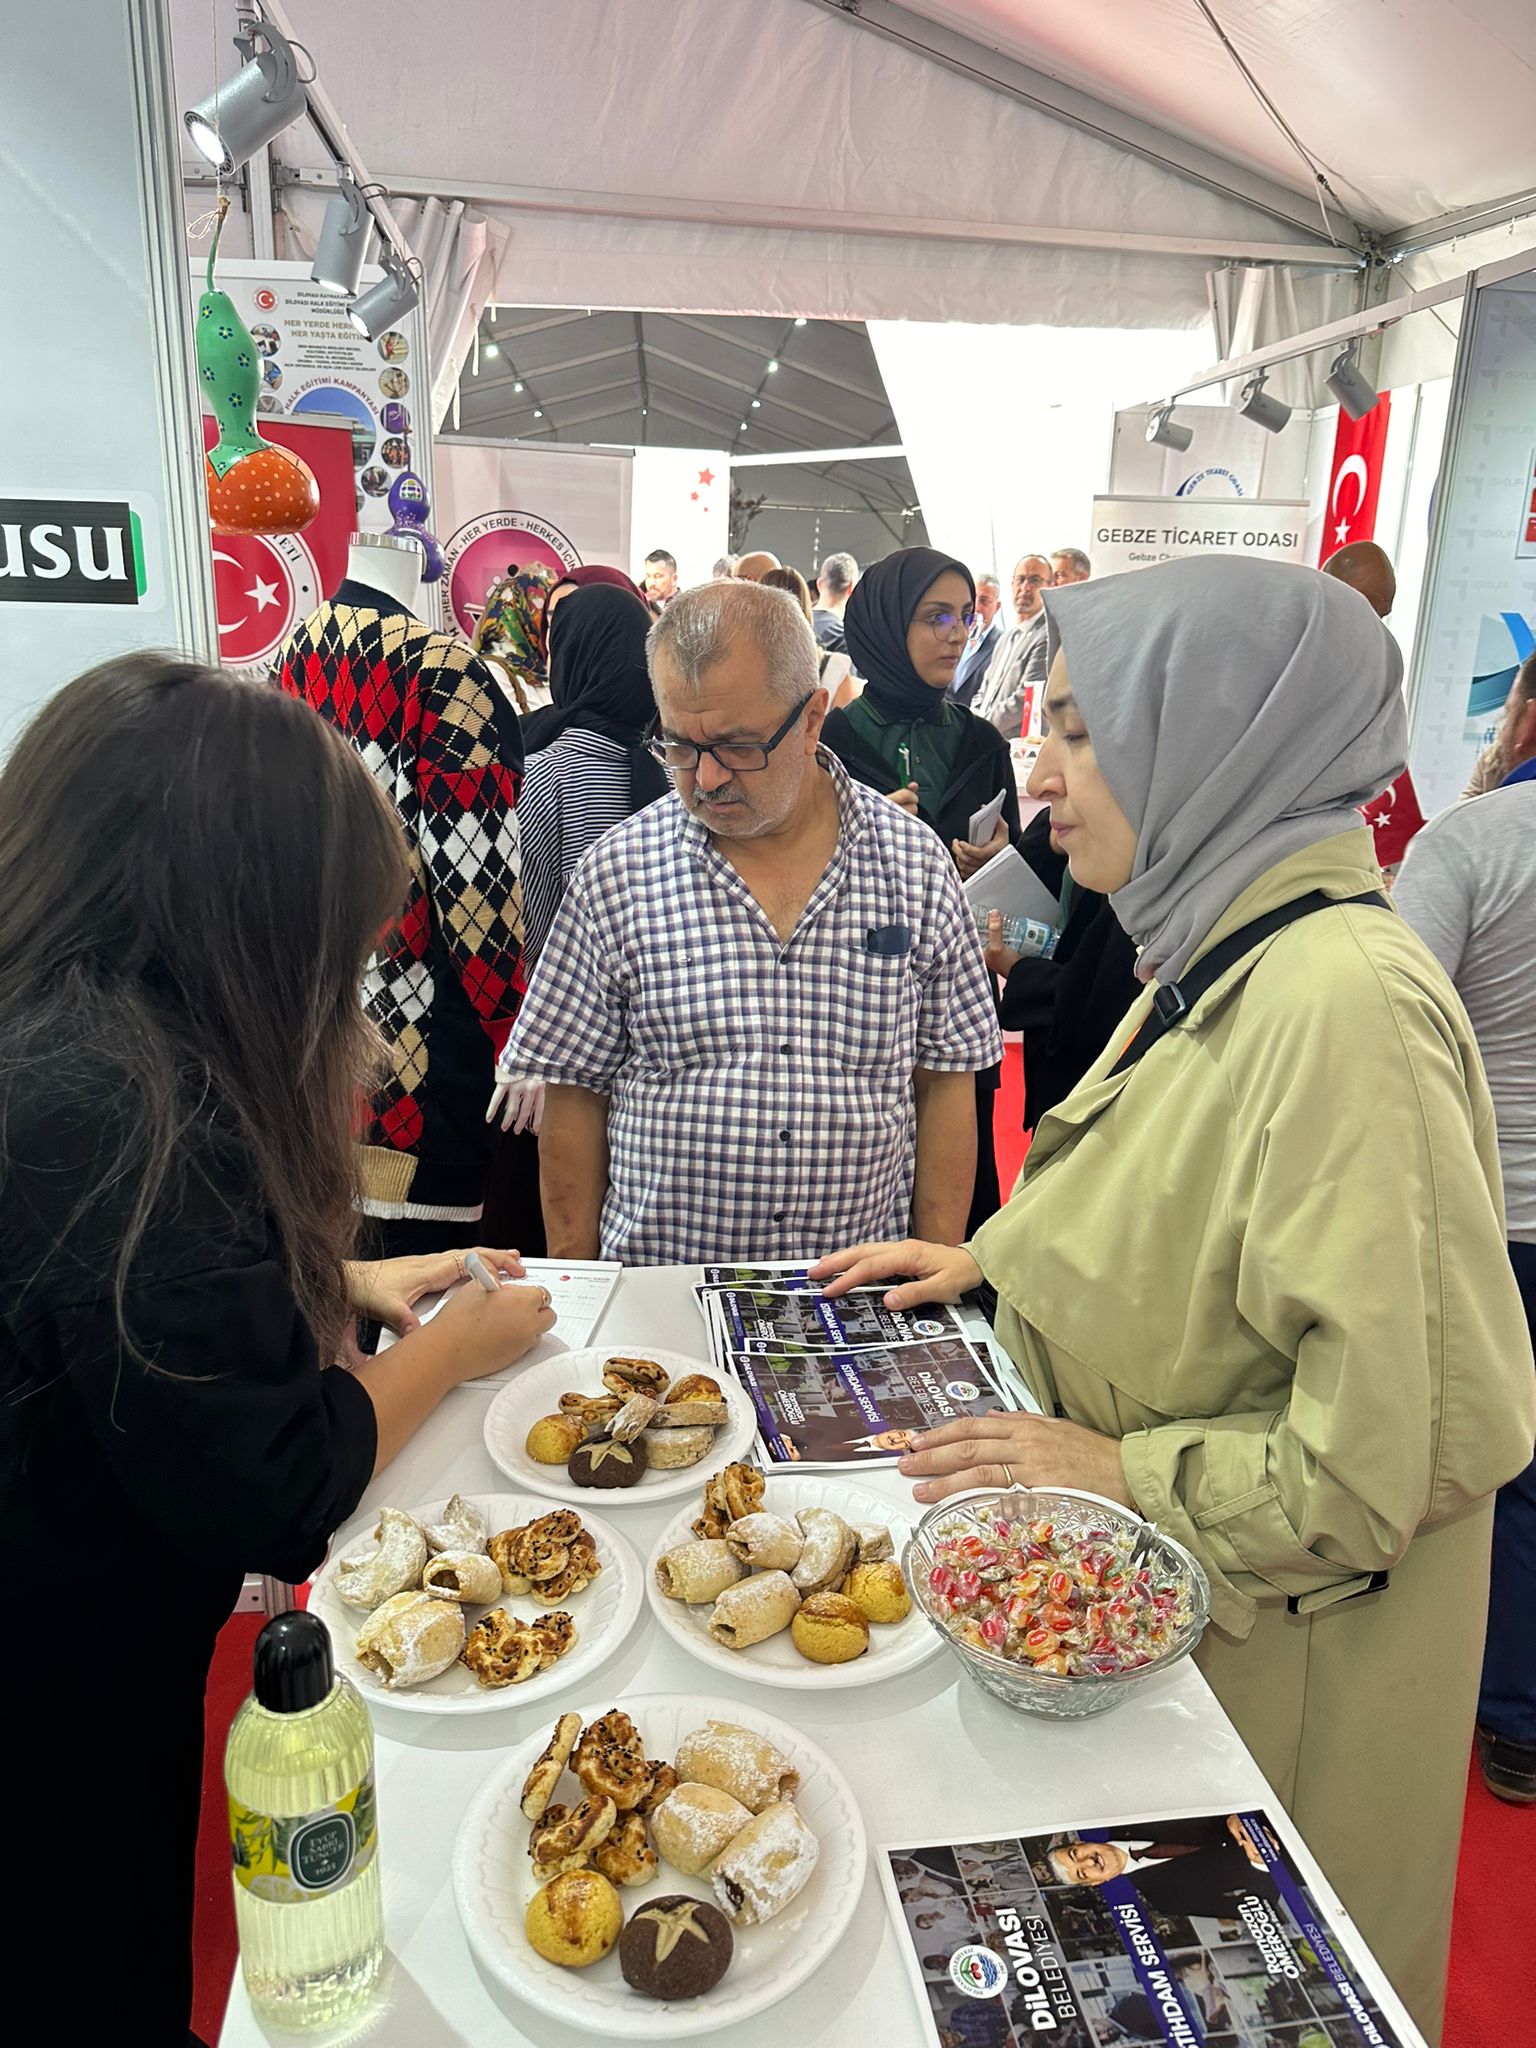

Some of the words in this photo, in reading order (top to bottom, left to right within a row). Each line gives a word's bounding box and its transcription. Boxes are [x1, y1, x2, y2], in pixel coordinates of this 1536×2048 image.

[284, 319, 302, 328] HER
[303, 320, 330, 329] YERDE
[291, 330, 309, 338] HER
[310, 331, 337, 340] YAŞTA
[284, 389, 302, 411] HALK
[301, 376, 332, 391] EĞİTİMİ
[333, 377, 380, 415] KAMPANYASI
[461, 526, 482, 547] HER
[482, 517, 518, 532] YERDE
[526, 521, 564, 551] HERKES
[1097, 528, 1156, 544] GEBZE
[1162, 526, 1237, 547] TİCARET
[1243, 532, 1298, 548] ODASI
[441, 548, 459, 588] ZAMAN
[1128, 552, 1156, 562] Gebze
[441, 588, 452, 613] HER
[890, 1311, 915, 1342] DİLOVA
[840, 1363, 865, 1397] İSTİHDAM
[857, 1396, 884, 1424] SERVİSİ
[906, 1375, 938, 1415] BELEDİYESİ
[1113, 1903, 1160, 1967] SERVİSİ
[1237, 1903, 1283, 1974] Ramazan
[1304, 1923, 1347, 1981] BELEDİYESİ
[1022, 1915, 1078, 2019] BELEDİYESİ
[1147, 1970, 1199, 2048] TİHDAM
